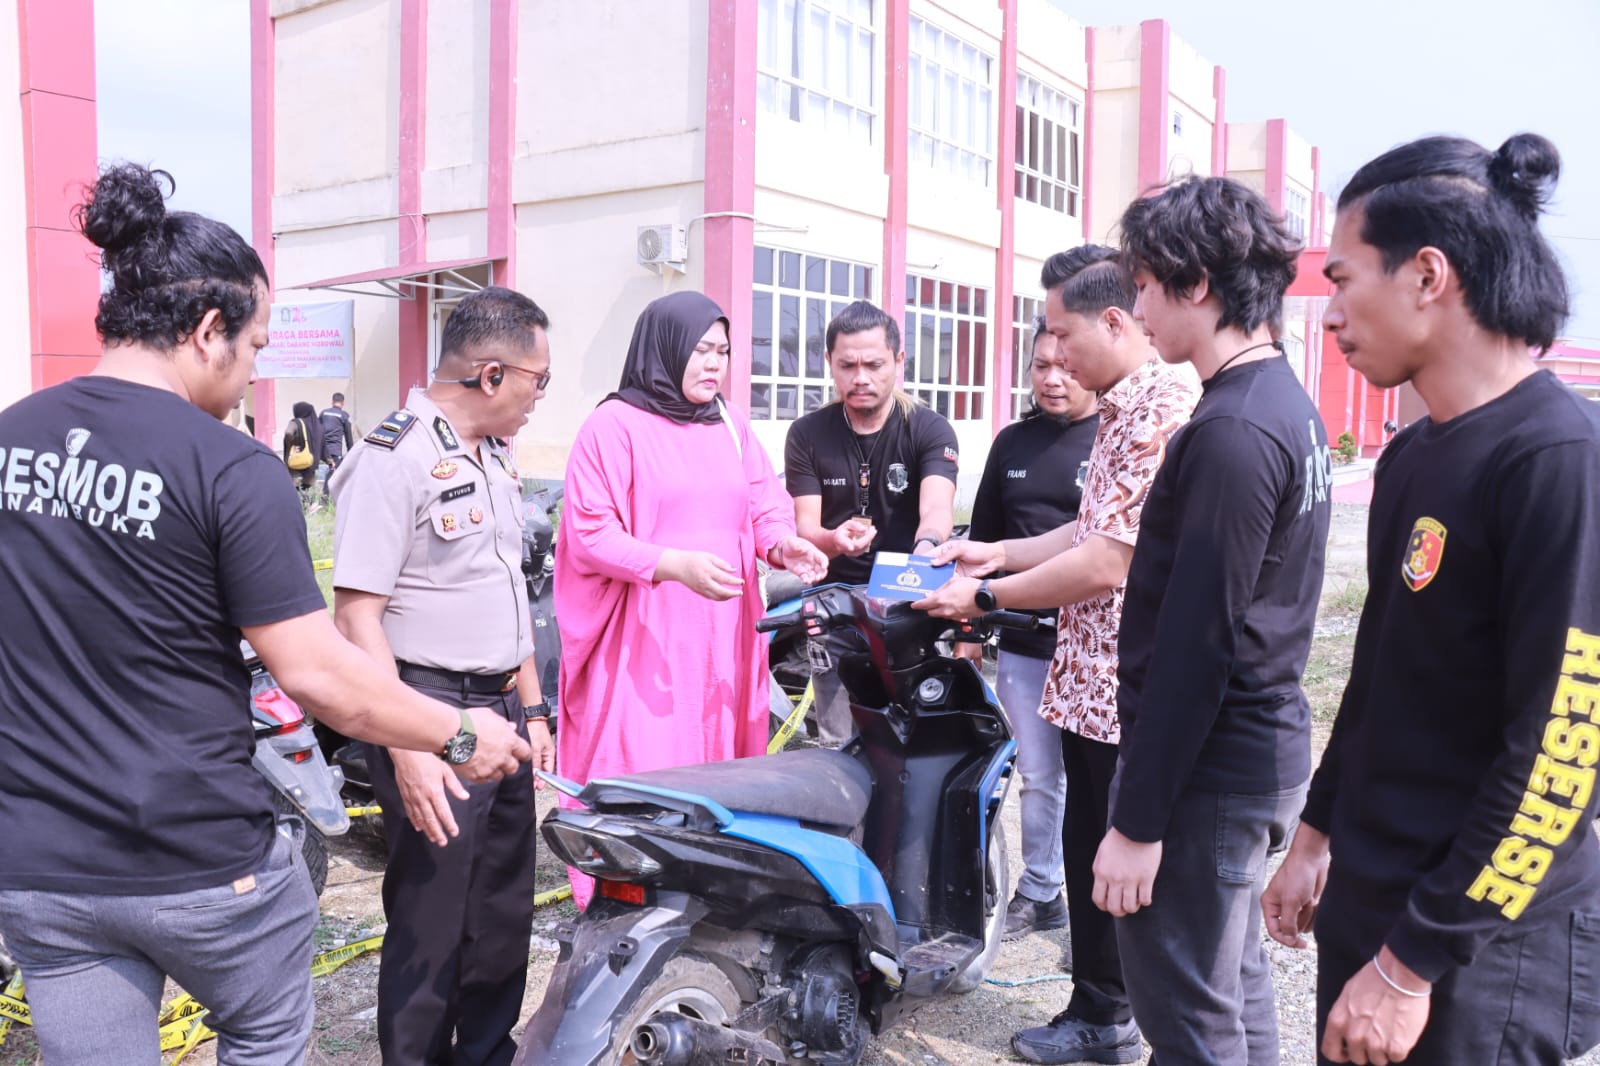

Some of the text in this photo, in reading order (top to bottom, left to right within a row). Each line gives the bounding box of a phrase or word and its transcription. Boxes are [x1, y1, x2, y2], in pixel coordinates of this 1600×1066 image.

[298, 329, 340, 339] BERSAMA
[0, 446, 164, 522] ESMOB
[1006, 469, 1027, 479] FRANS
[1465, 626, 1600, 921] RESERSE
